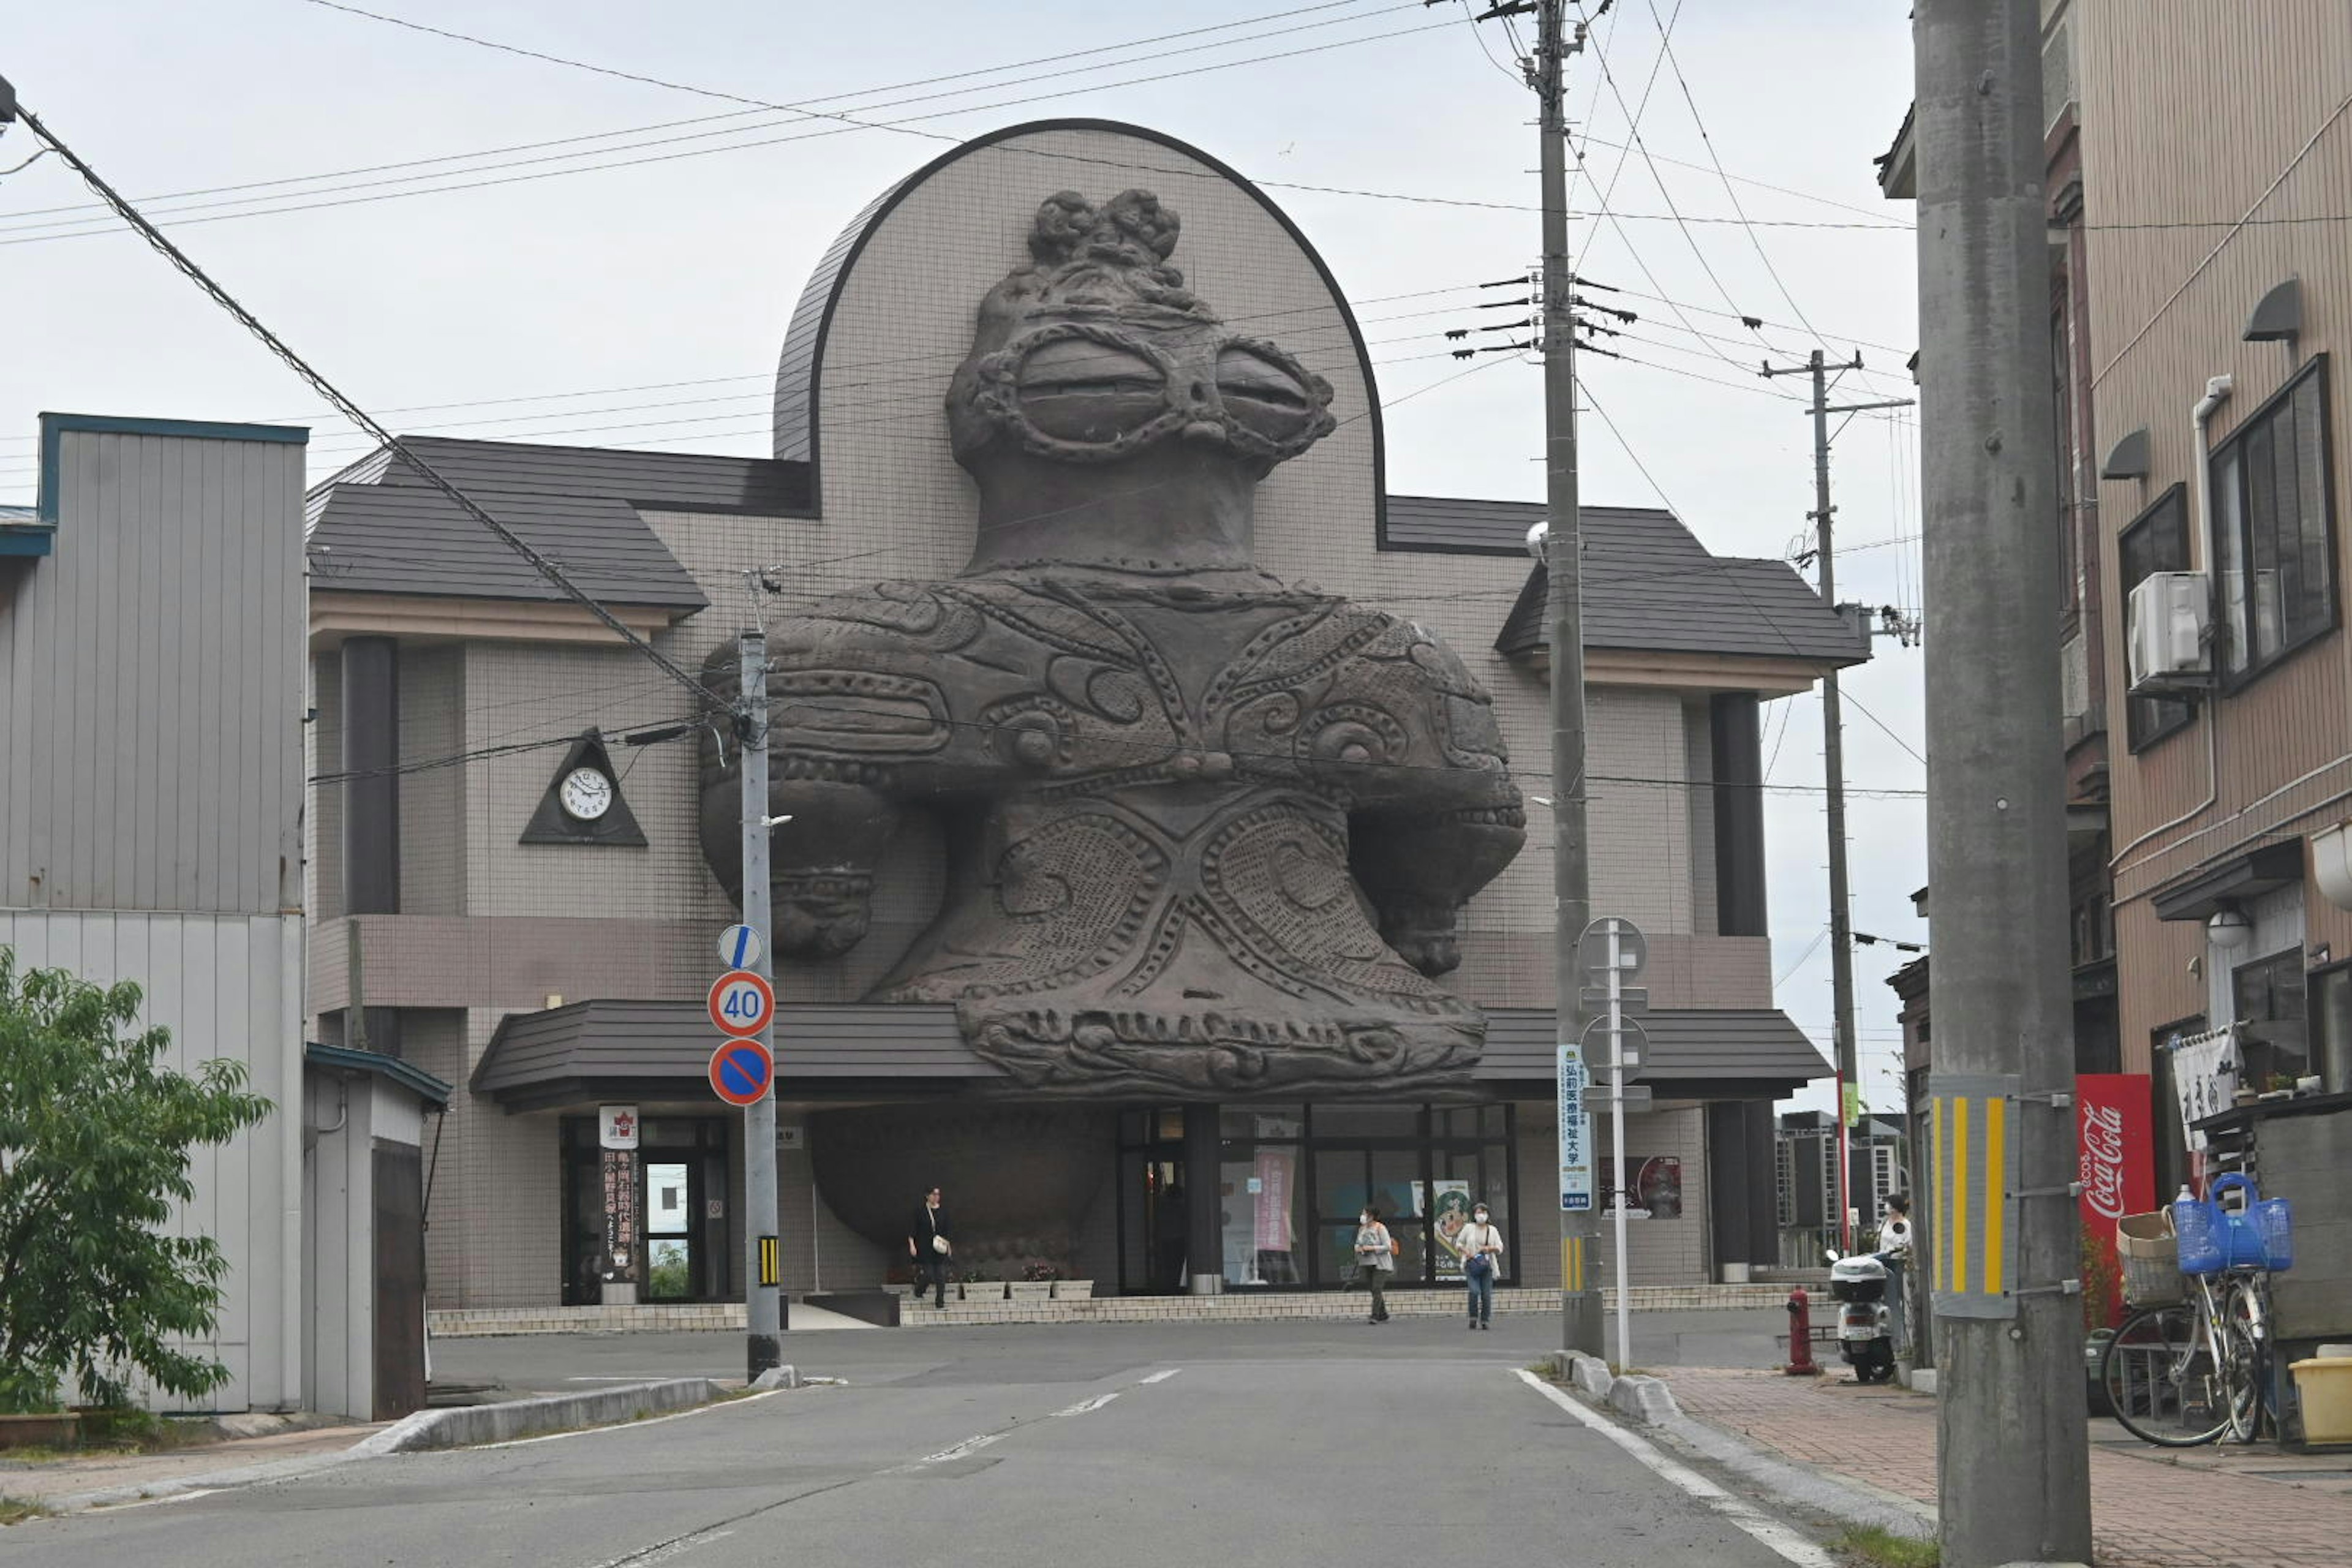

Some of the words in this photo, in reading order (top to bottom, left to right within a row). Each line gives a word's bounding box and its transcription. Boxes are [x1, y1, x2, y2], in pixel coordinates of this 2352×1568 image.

[724, 990, 758, 1018] 40
[1566, 1065, 1579, 1164] 弘前医療福祉大学
[2082, 1099, 2123, 1219] Coca-Cola
